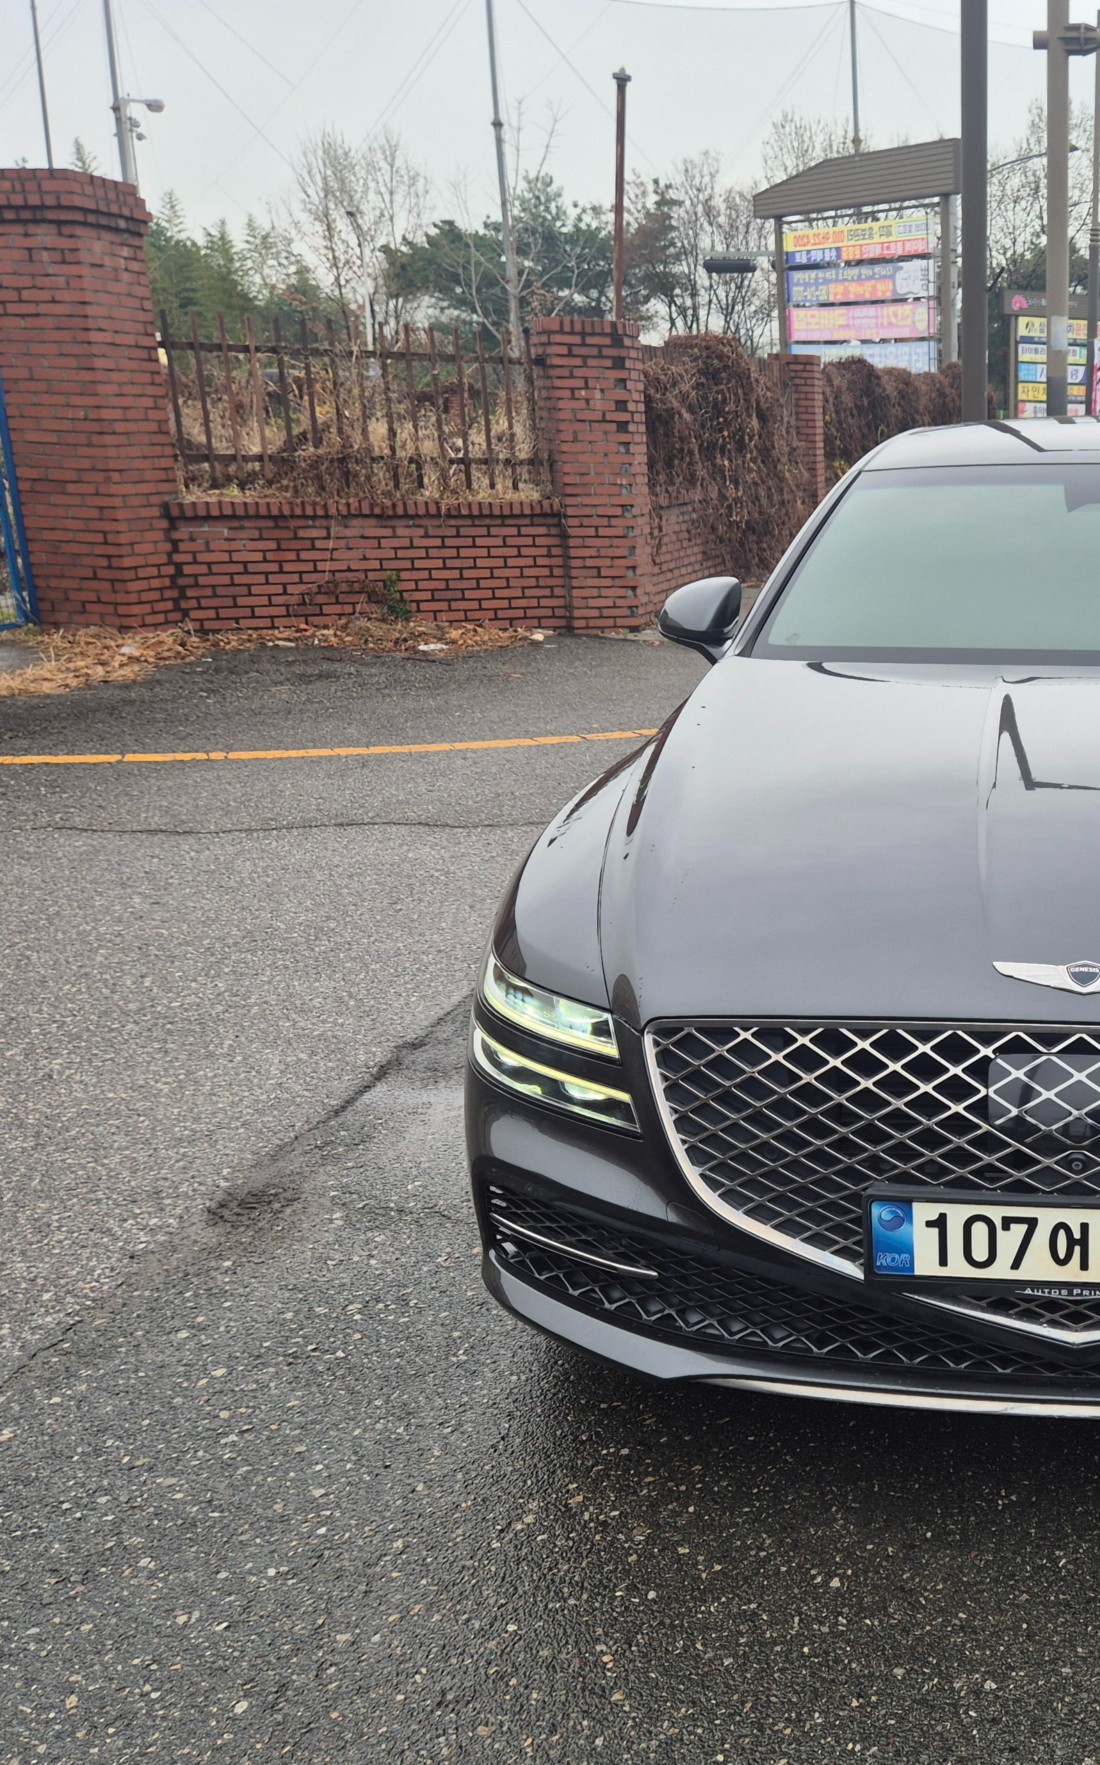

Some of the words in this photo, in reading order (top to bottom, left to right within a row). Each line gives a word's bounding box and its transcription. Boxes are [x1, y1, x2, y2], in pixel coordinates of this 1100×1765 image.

[1070, 966, 1100, 974] GENESIS
[925, 1211, 1090, 1272] 107어
[875, 1252, 911, 1268] KOR
